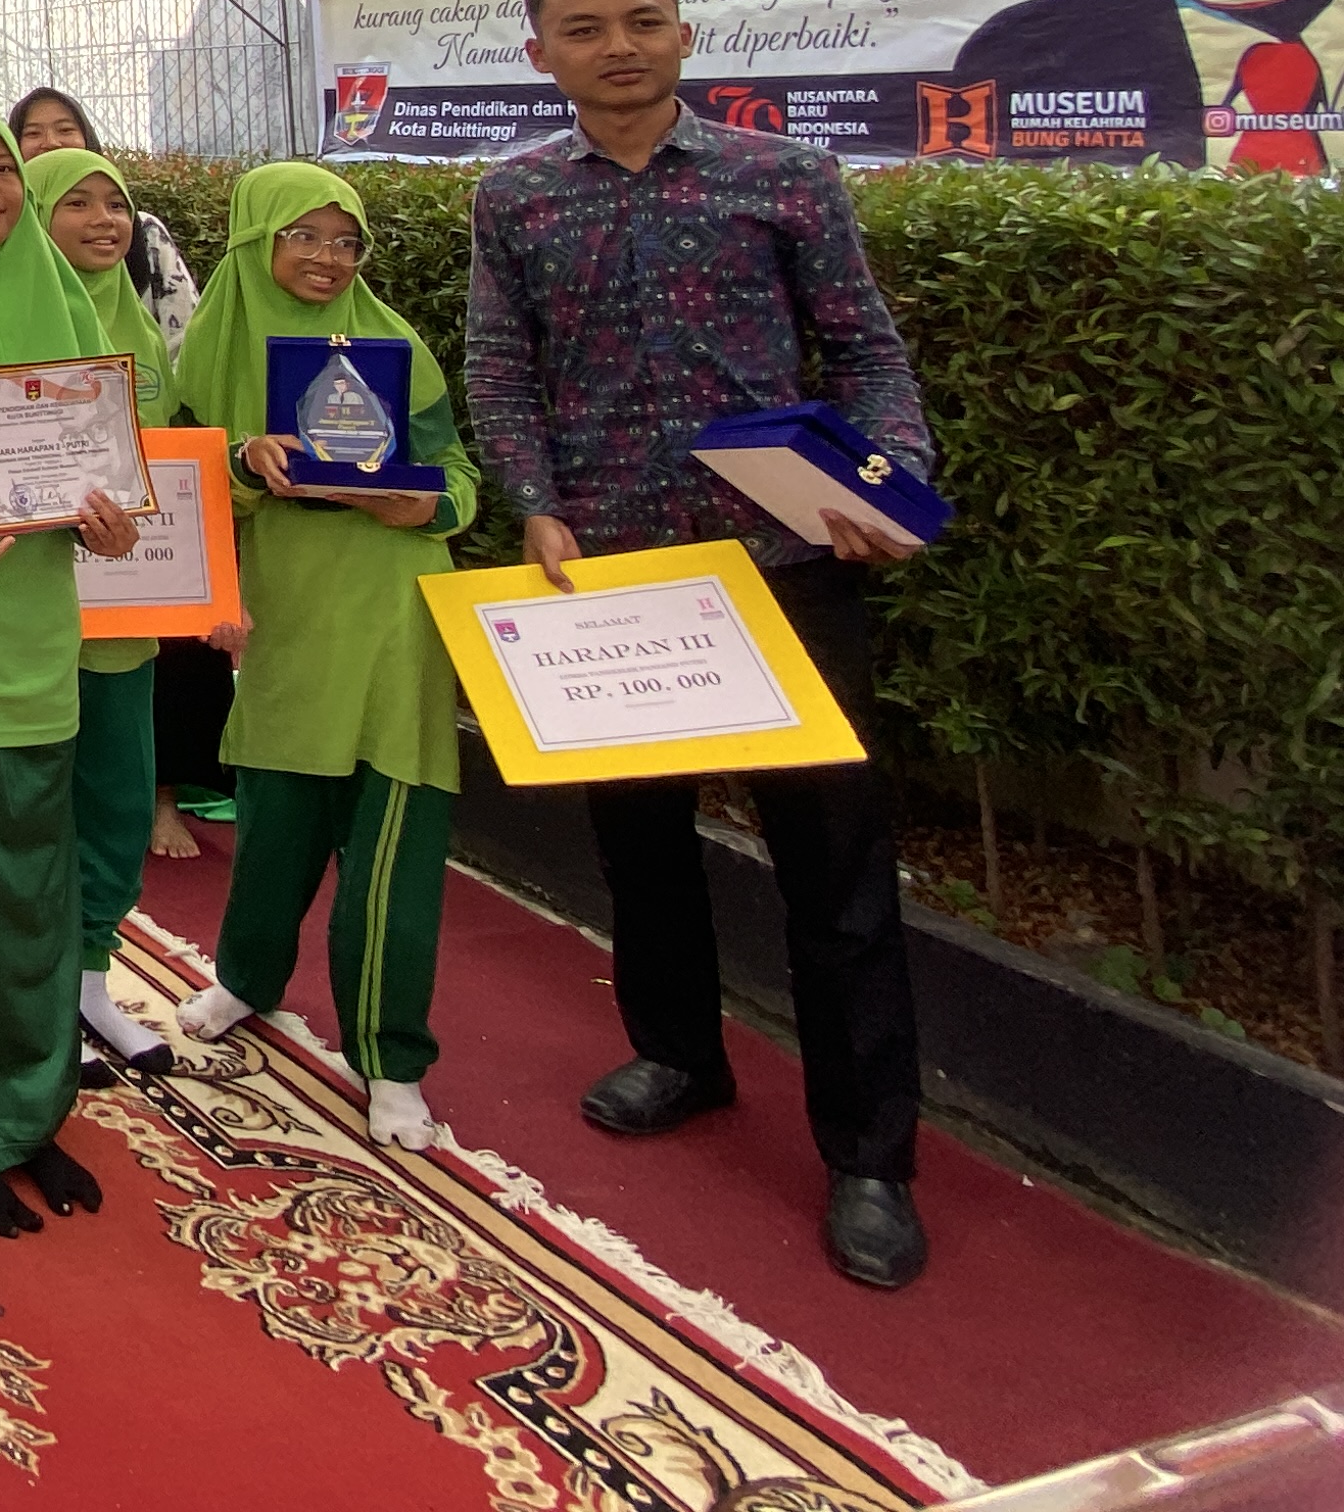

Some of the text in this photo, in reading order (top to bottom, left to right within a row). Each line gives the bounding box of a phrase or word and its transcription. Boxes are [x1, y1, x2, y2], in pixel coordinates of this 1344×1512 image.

[353, 3, 423, 35] kurang
[433, 32, 525, 70] Namun
[787, 90, 879, 103] NUSANTARA
[1010, 90, 1145, 115] MUSEUM
[394, 101, 437, 117] Dinas
[441, 101, 528, 117] Pendidikan
[532, 101, 562, 116] dan
[787, 106, 828, 118] BARU
[389, 120, 516, 141] Kota Bukittinggi
[787, 122, 870, 136] INDONESIA
[1011, 116, 1146, 130] RUMAH KELAHIRAN
[1012, 131, 1145, 147] BUNG HATTA
[144, 547, 174, 561] 000
[574, 615, 641, 630] SELAMAT
[532, 632, 716, 668] HARAPAN III
[563, 670, 722, 702] RP. 100. 000
